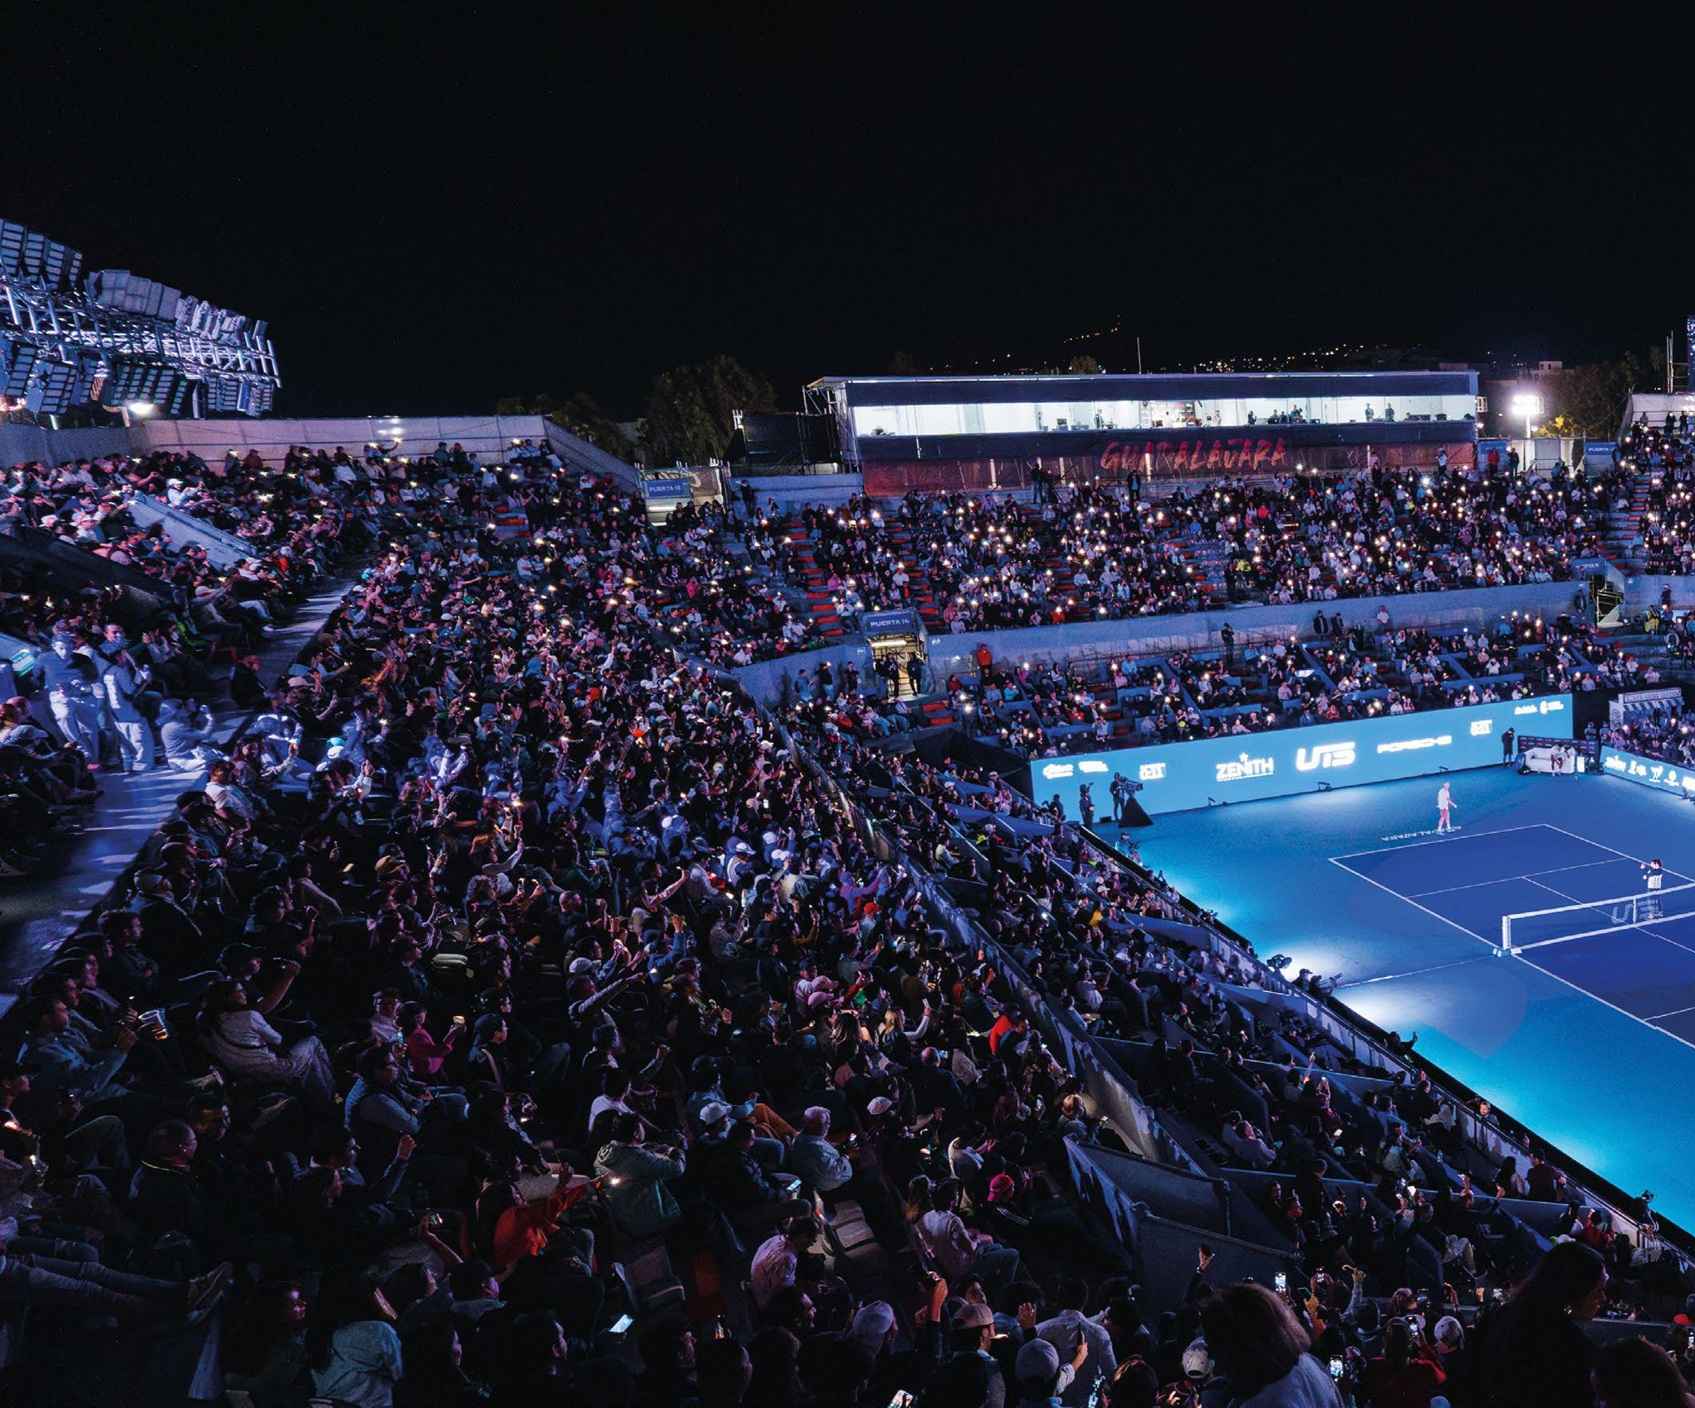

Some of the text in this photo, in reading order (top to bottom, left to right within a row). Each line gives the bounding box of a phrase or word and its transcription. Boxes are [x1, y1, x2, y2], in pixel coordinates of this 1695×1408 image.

[870, 619, 900, 627] PUERTA
[1296, 741, 1356, 771] UTS
[1216, 757, 1274, 779] ZENITH
